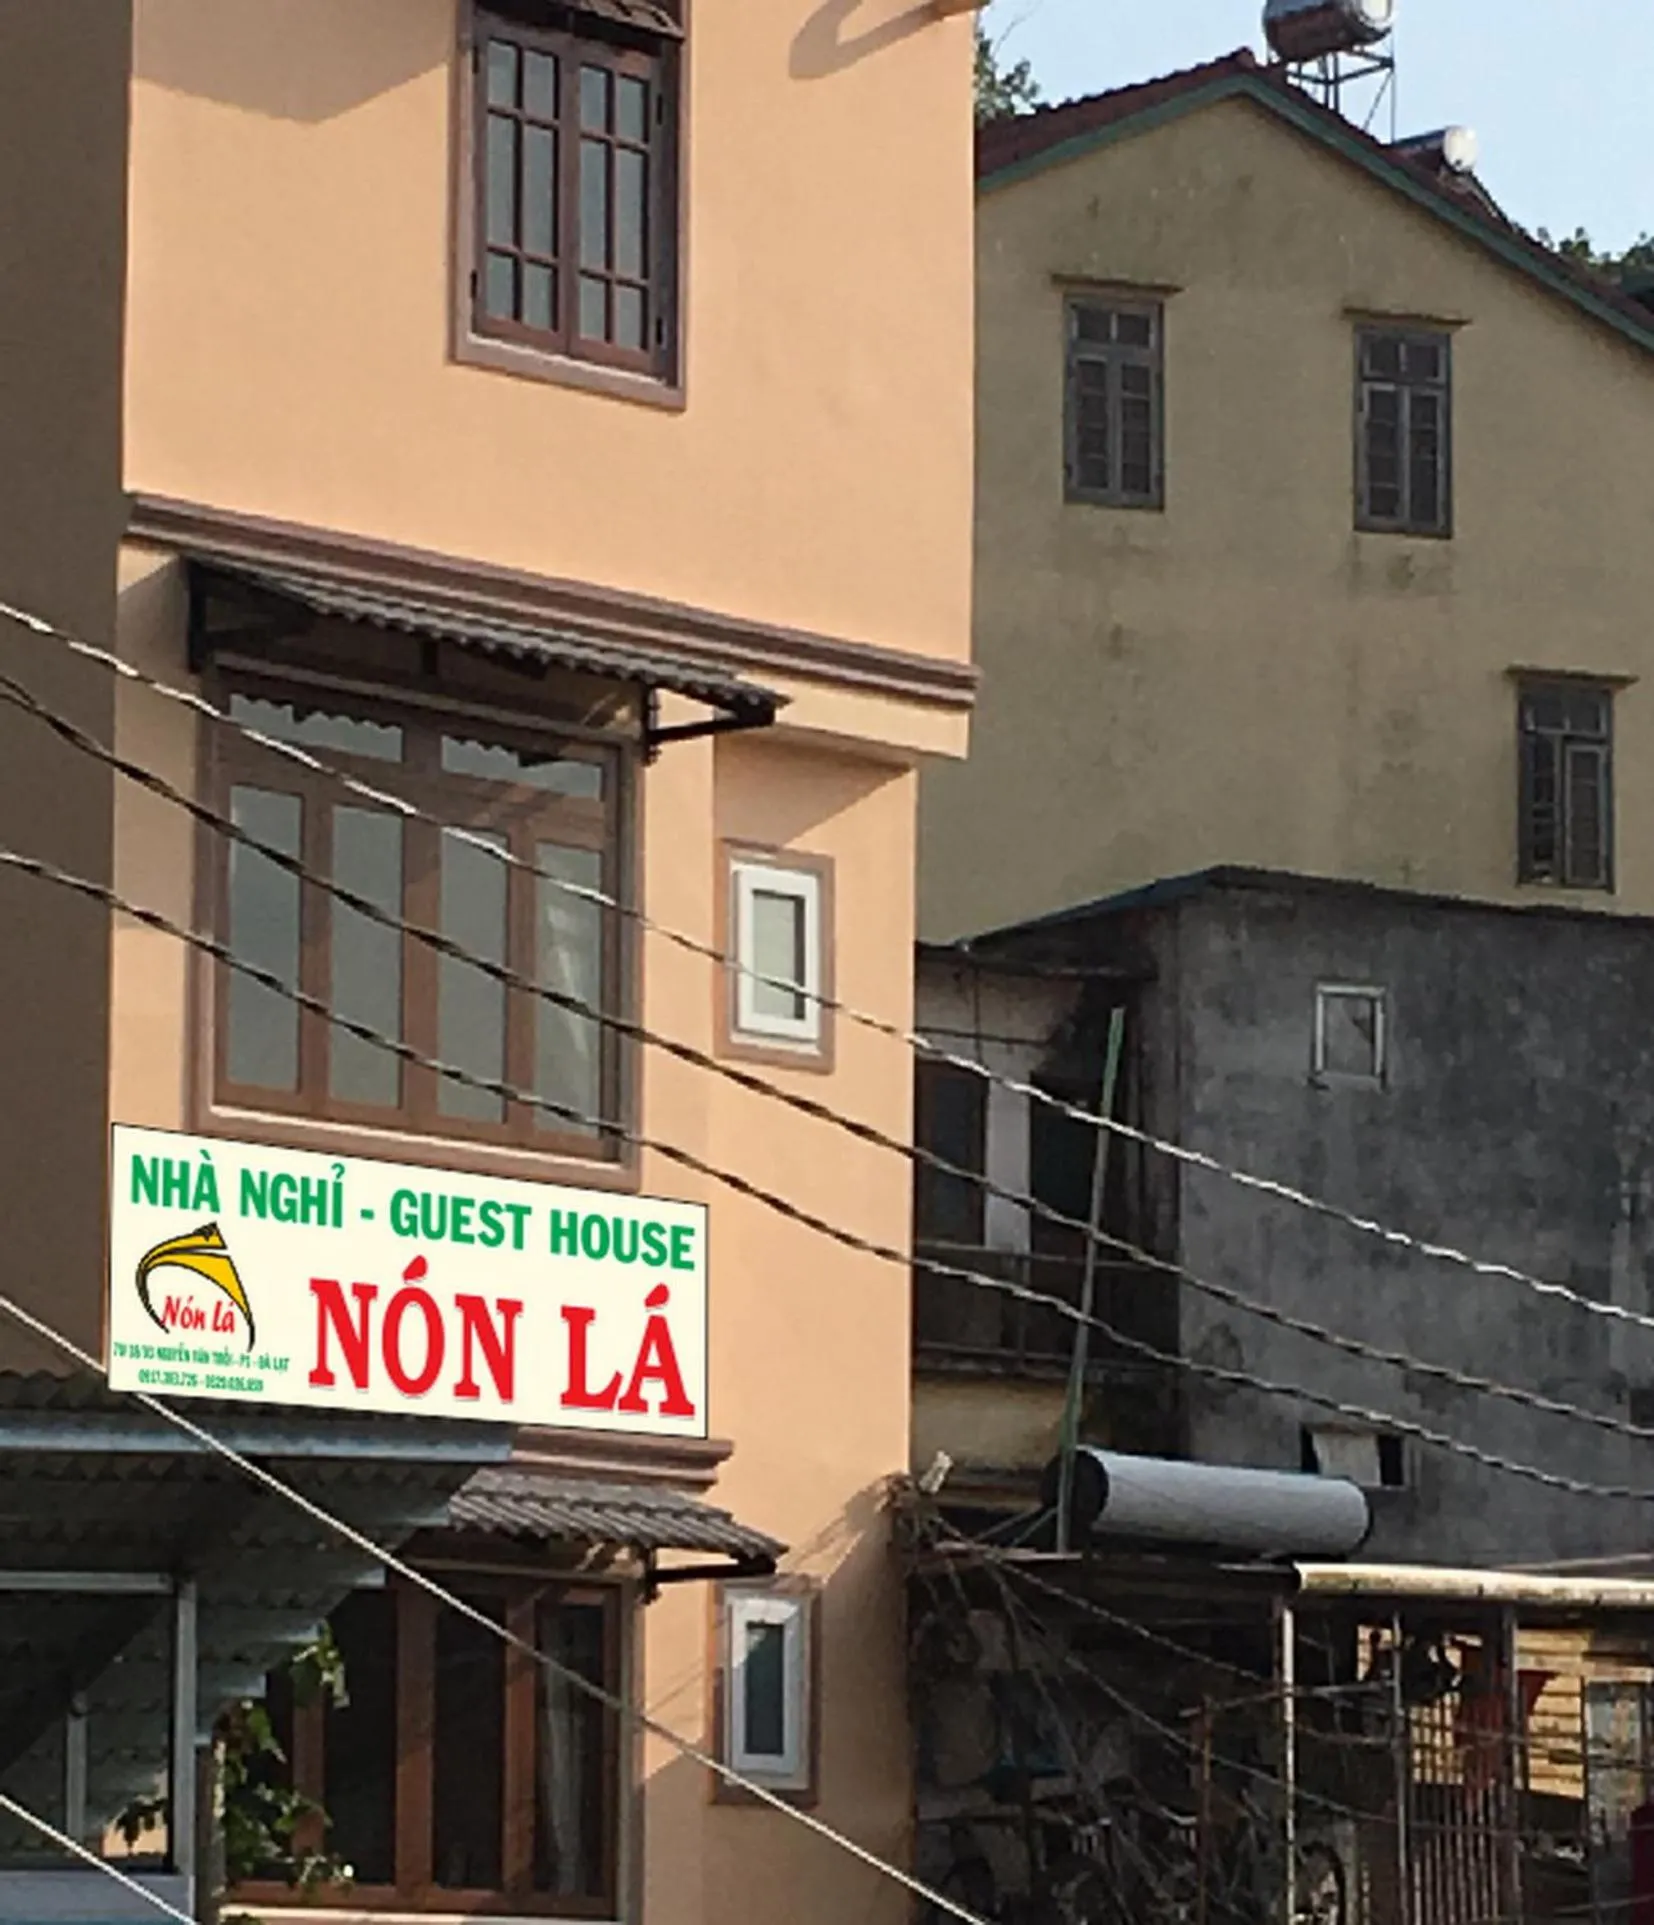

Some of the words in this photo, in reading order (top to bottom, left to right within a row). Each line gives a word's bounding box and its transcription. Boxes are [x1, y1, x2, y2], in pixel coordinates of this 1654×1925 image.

[131, 1149, 221, 1213] NHÀ
[240, 1162, 346, 1228] NGHỈ
[390, 1189, 532, 1250] GUEST
[550, 1209, 696, 1271] HOUSE
[161, 1295, 205, 1330] Nón
[212, 1300, 235, 1333] Lá
[308, 1255, 523, 1403] NÓN
[560, 1283, 696, 1418] LÁ
